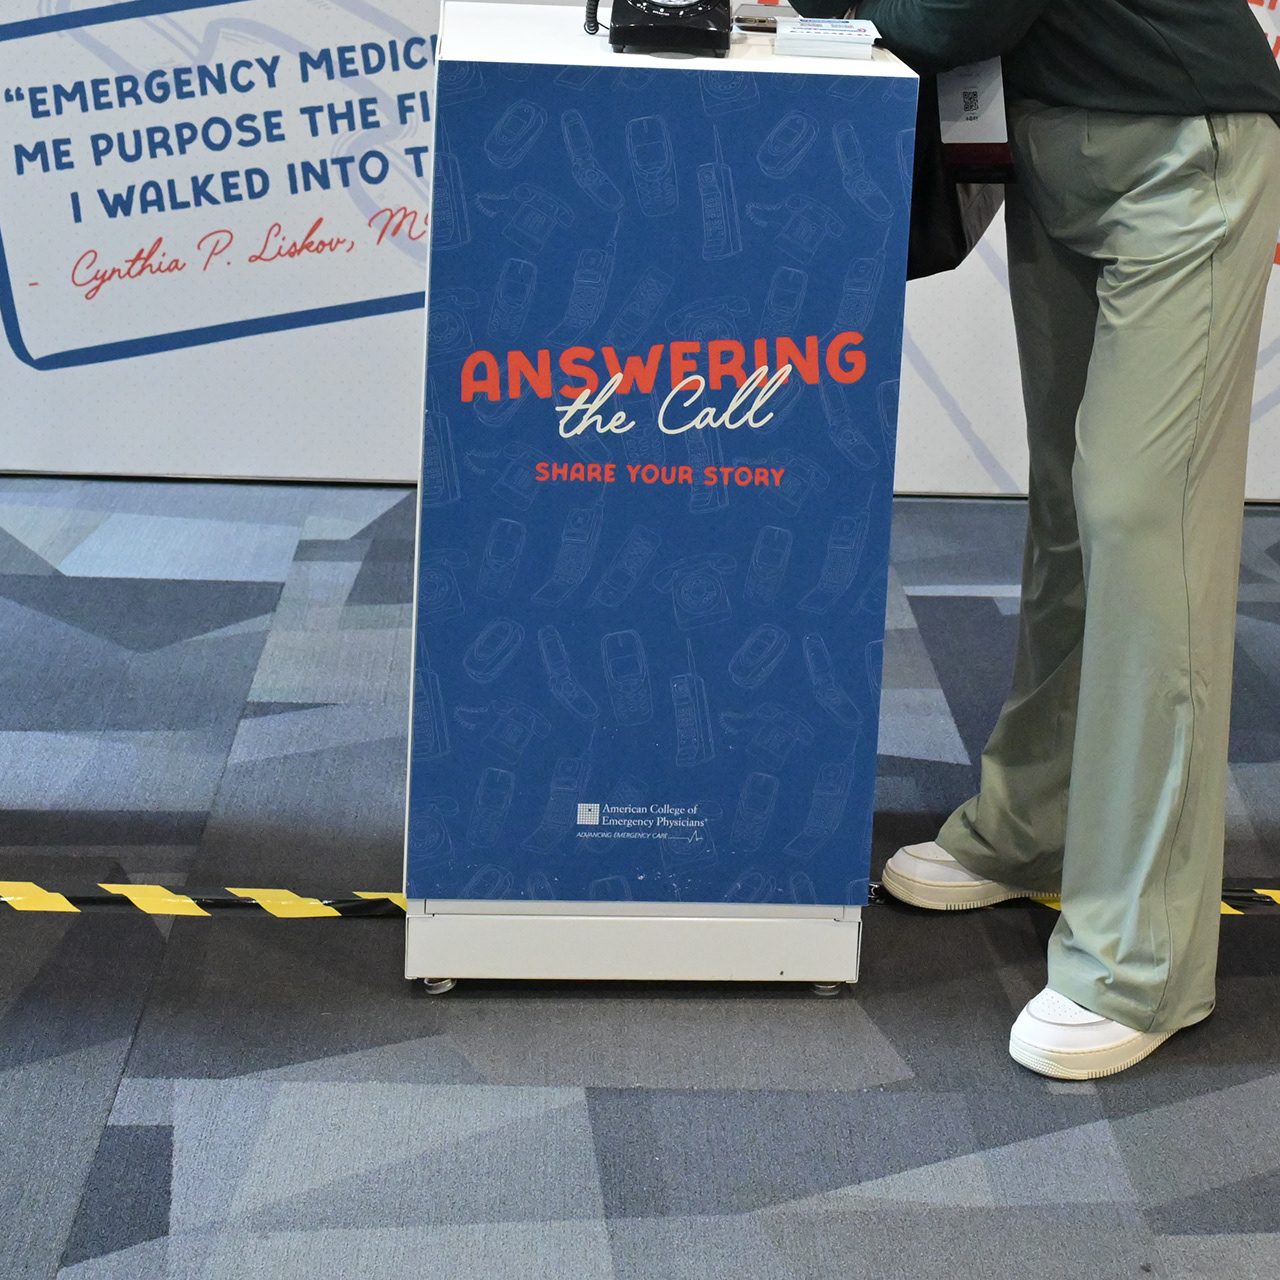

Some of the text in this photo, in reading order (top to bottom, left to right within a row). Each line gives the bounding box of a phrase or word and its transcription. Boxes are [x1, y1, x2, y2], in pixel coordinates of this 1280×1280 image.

[14, 138, 74, 175] ME
[90, 110, 285, 166] PURPOSE
[300, 97, 380, 137] THE
[71, 192, 82, 223] I
[97, 168, 270, 218] WALKED
[287, 150, 389, 194] INTO
[72, 238, 185, 299] Cynthia
[198, 230, 233, 269] P.
[460, 331, 866, 403] ANSWERING
[554, 363, 793, 438] the Call
[536, 462, 784, 486] SHARE YOUR STORY
[602, 804, 699, 815] American College of
[602, 818, 655, 829] Emergency
